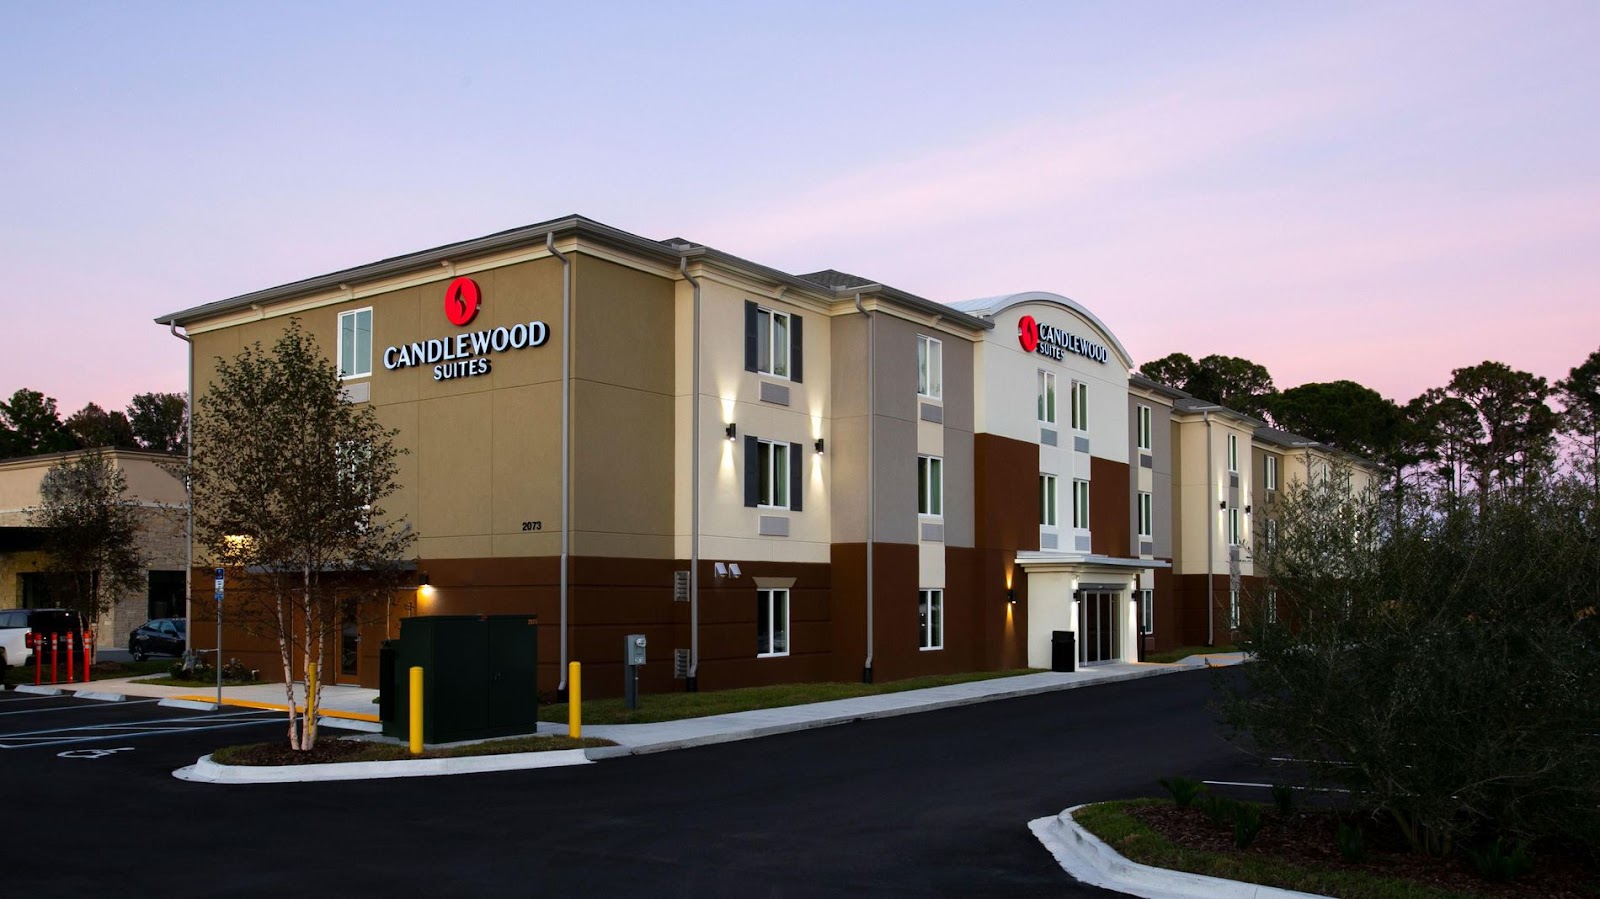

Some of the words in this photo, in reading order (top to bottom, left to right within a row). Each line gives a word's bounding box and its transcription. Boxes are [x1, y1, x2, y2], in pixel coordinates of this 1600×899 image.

[383, 320, 548, 370] CANDLEWOOD
[1039, 323, 1108, 363] CANDLEWOOD
[1040, 342, 1065, 360] SUITES
[433, 357, 489, 381] SUITES
[522, 521, 542, 531] 2073
